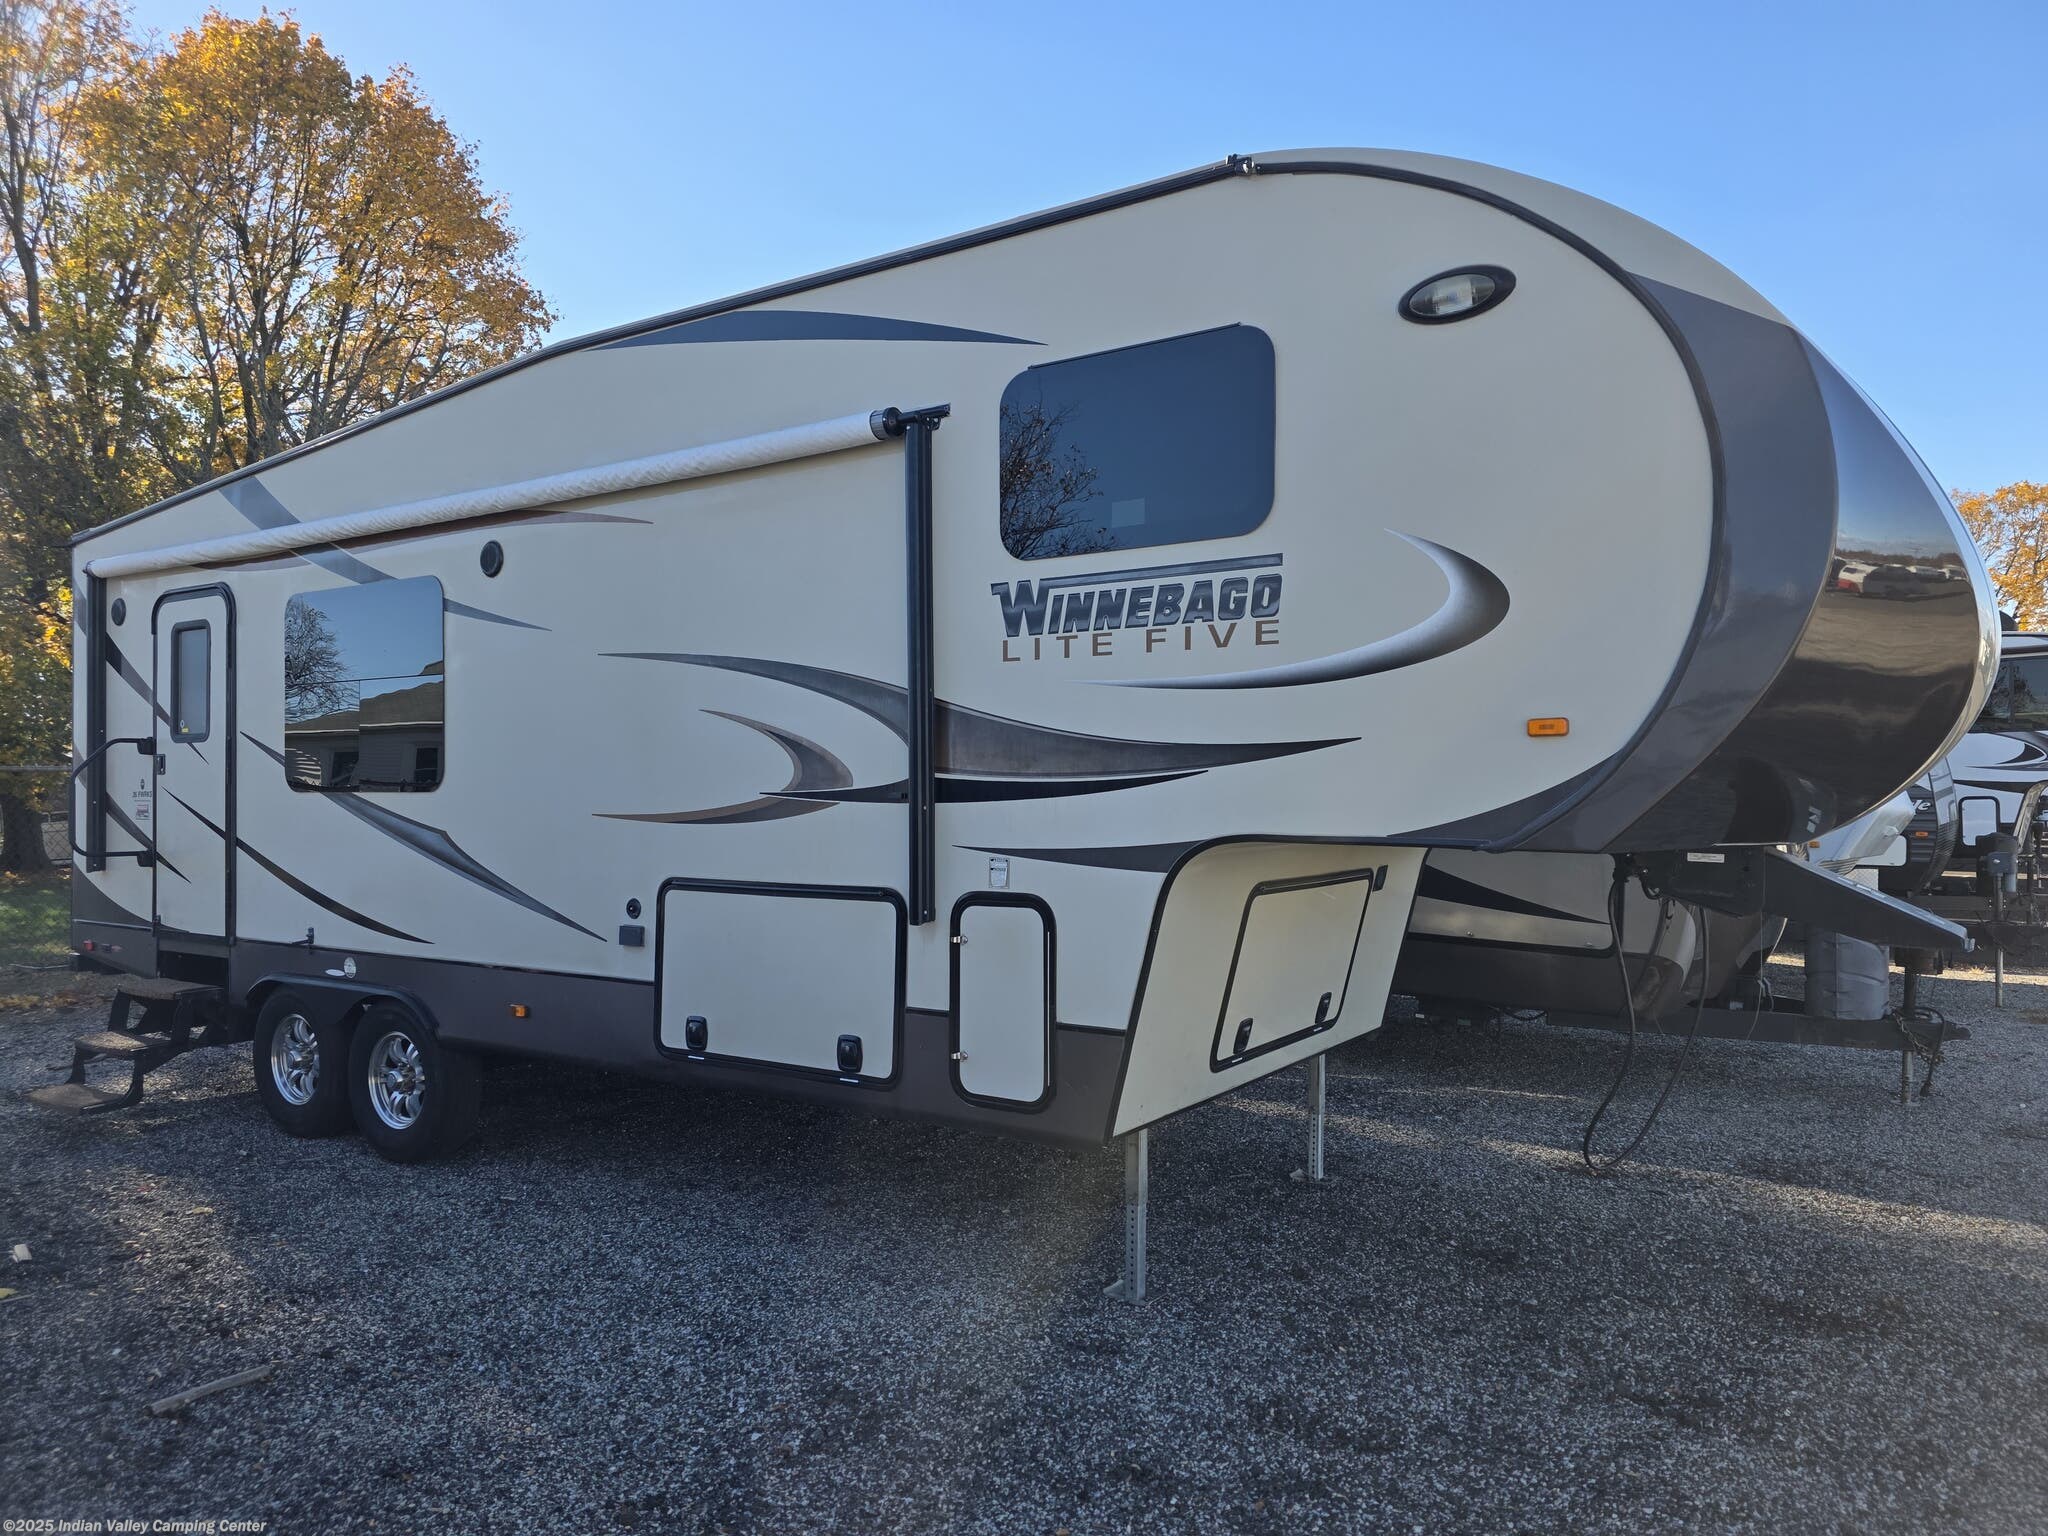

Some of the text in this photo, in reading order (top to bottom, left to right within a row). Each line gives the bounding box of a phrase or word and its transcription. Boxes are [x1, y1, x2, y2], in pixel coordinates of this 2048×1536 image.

[990, 572, 1284, 638] WINNEBAGO
[1002, 619, 1280, 663] LITE FIVE
